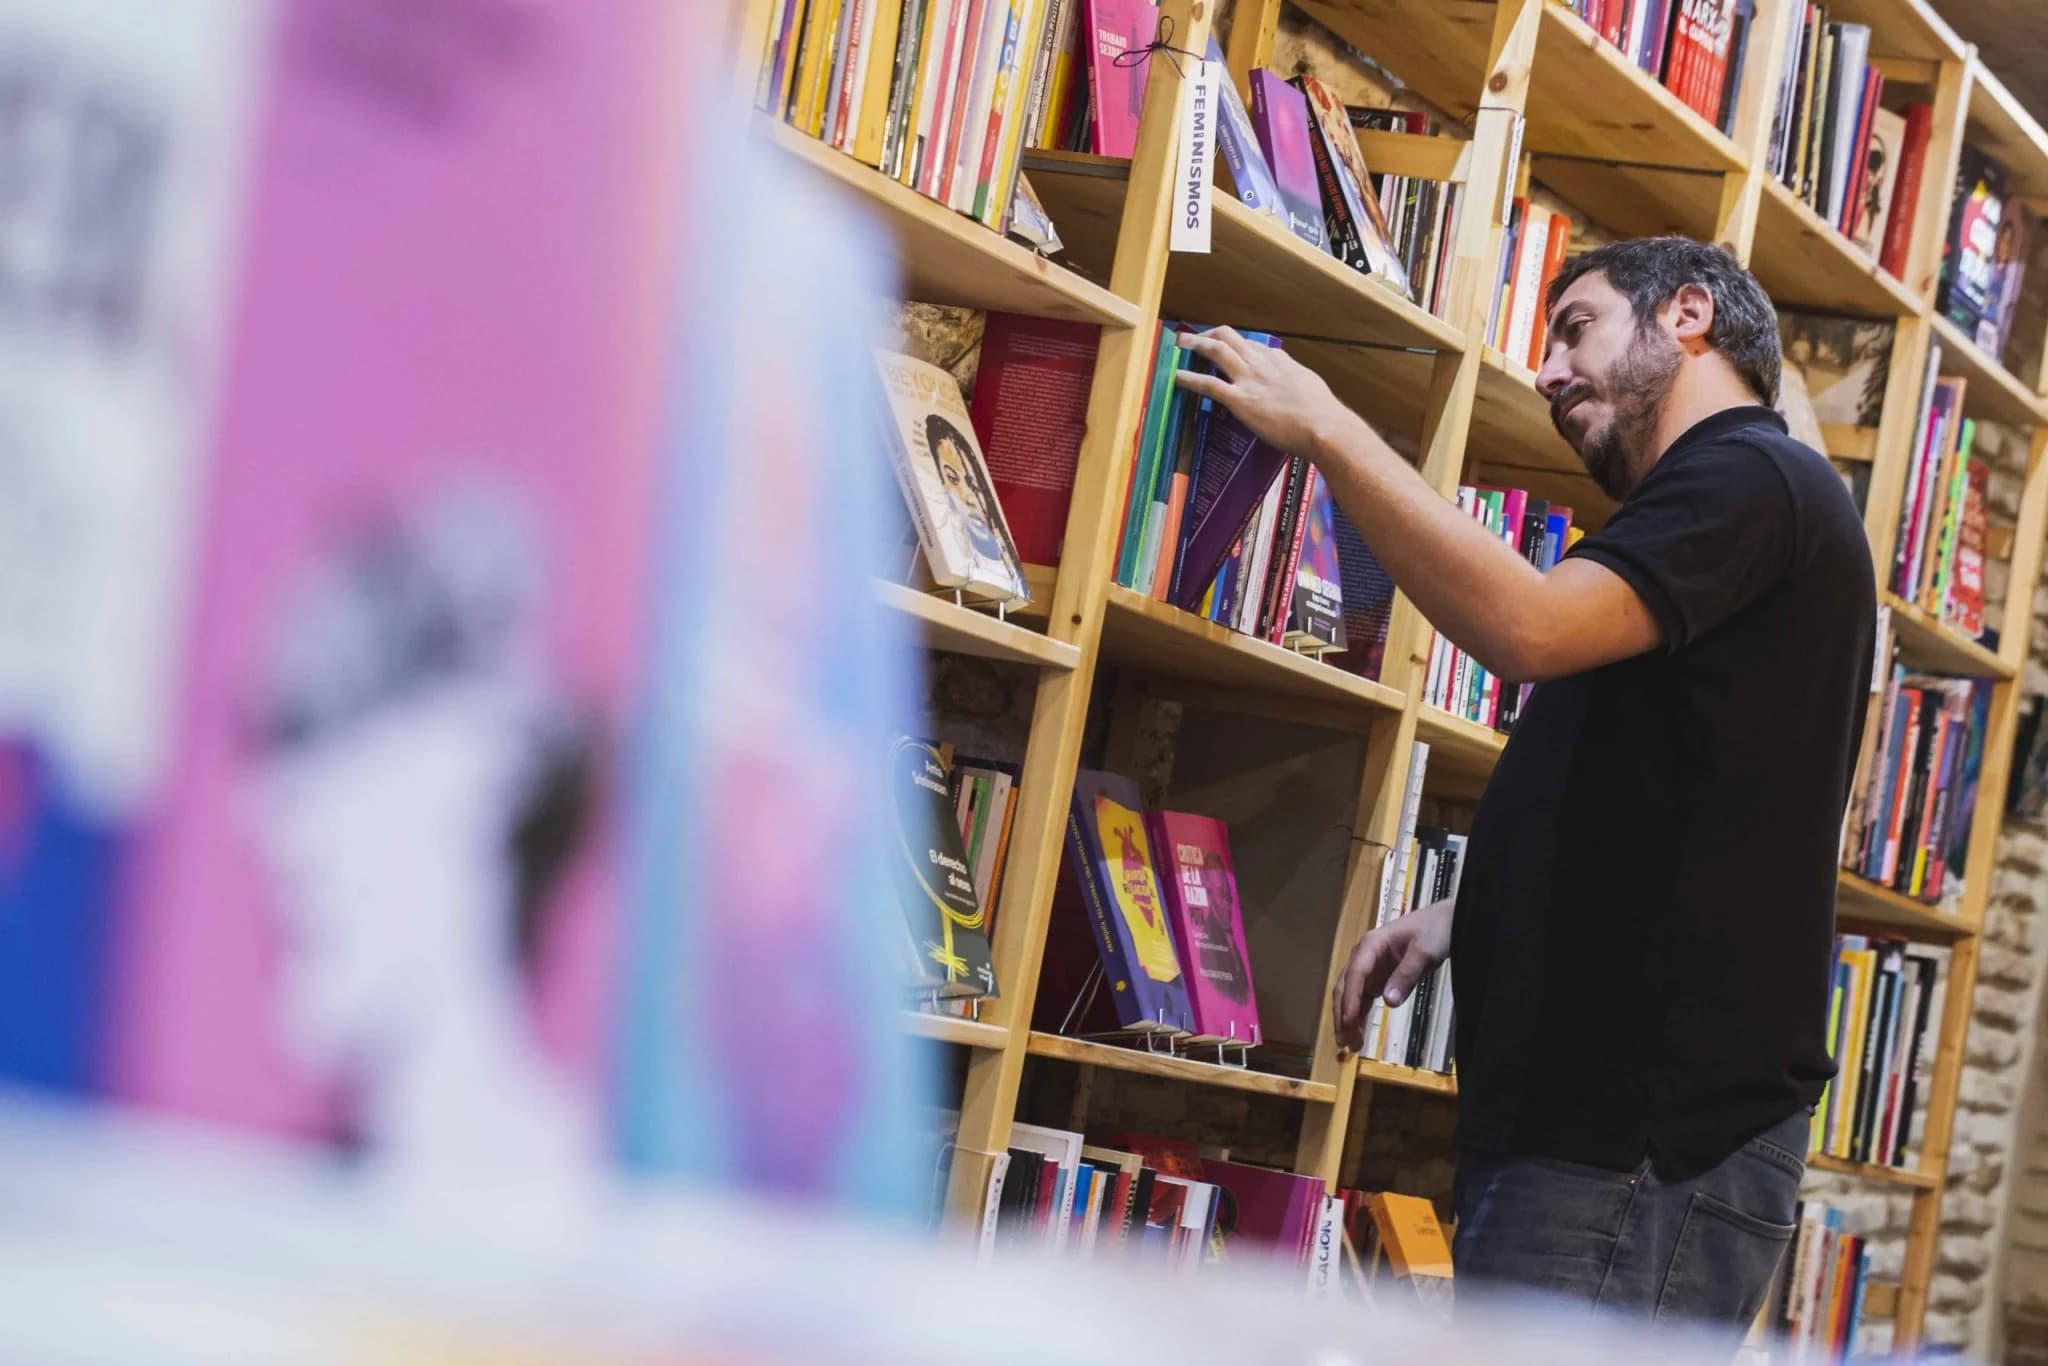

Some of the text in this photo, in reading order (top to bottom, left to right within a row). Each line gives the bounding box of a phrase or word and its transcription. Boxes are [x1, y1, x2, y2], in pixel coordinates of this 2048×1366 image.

[1098, 29, 1127, 48] TRABAJO
[1186, 84, 1207, 230] FEMINISMOS
[1287, 555, 1297, 575] PARA
[1282, 575, 1293, 607] SALARIO
[937, 852, 968, 875] derecho
